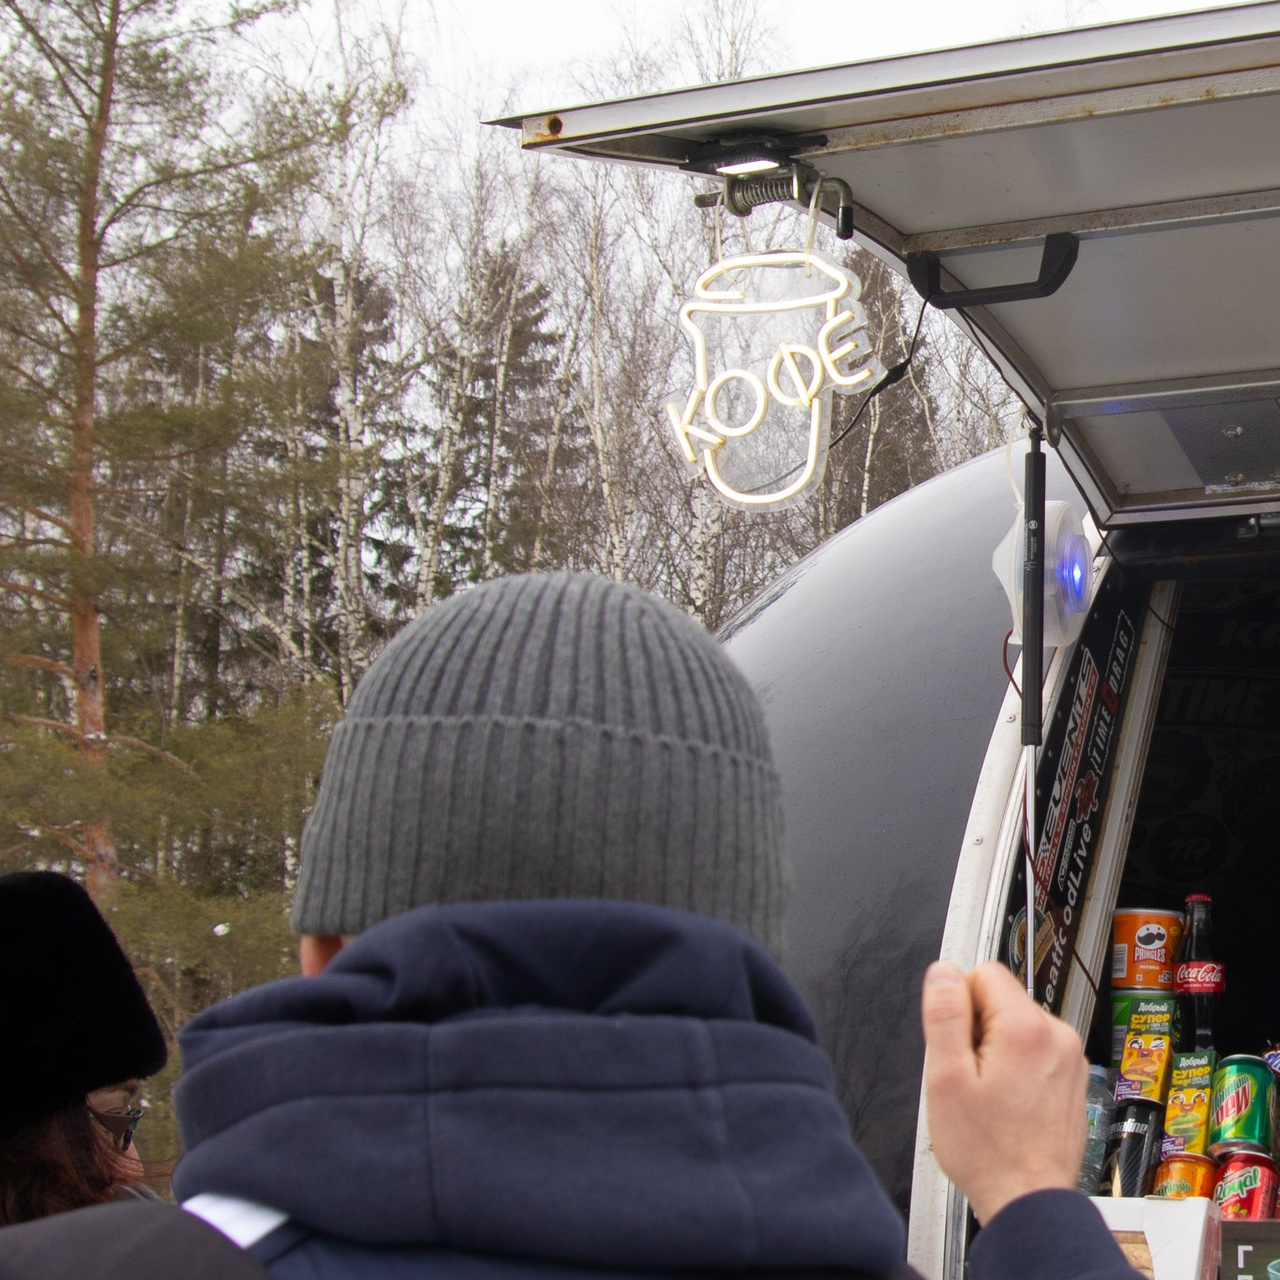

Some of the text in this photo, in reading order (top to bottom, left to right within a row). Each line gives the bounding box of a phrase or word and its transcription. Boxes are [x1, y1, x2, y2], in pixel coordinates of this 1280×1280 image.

[666, 310, 874, 464] КОФЕ
[1134, 946, 1166, 963] PRINGLES
[1138, 1002, 1168, 1013] Добрый
